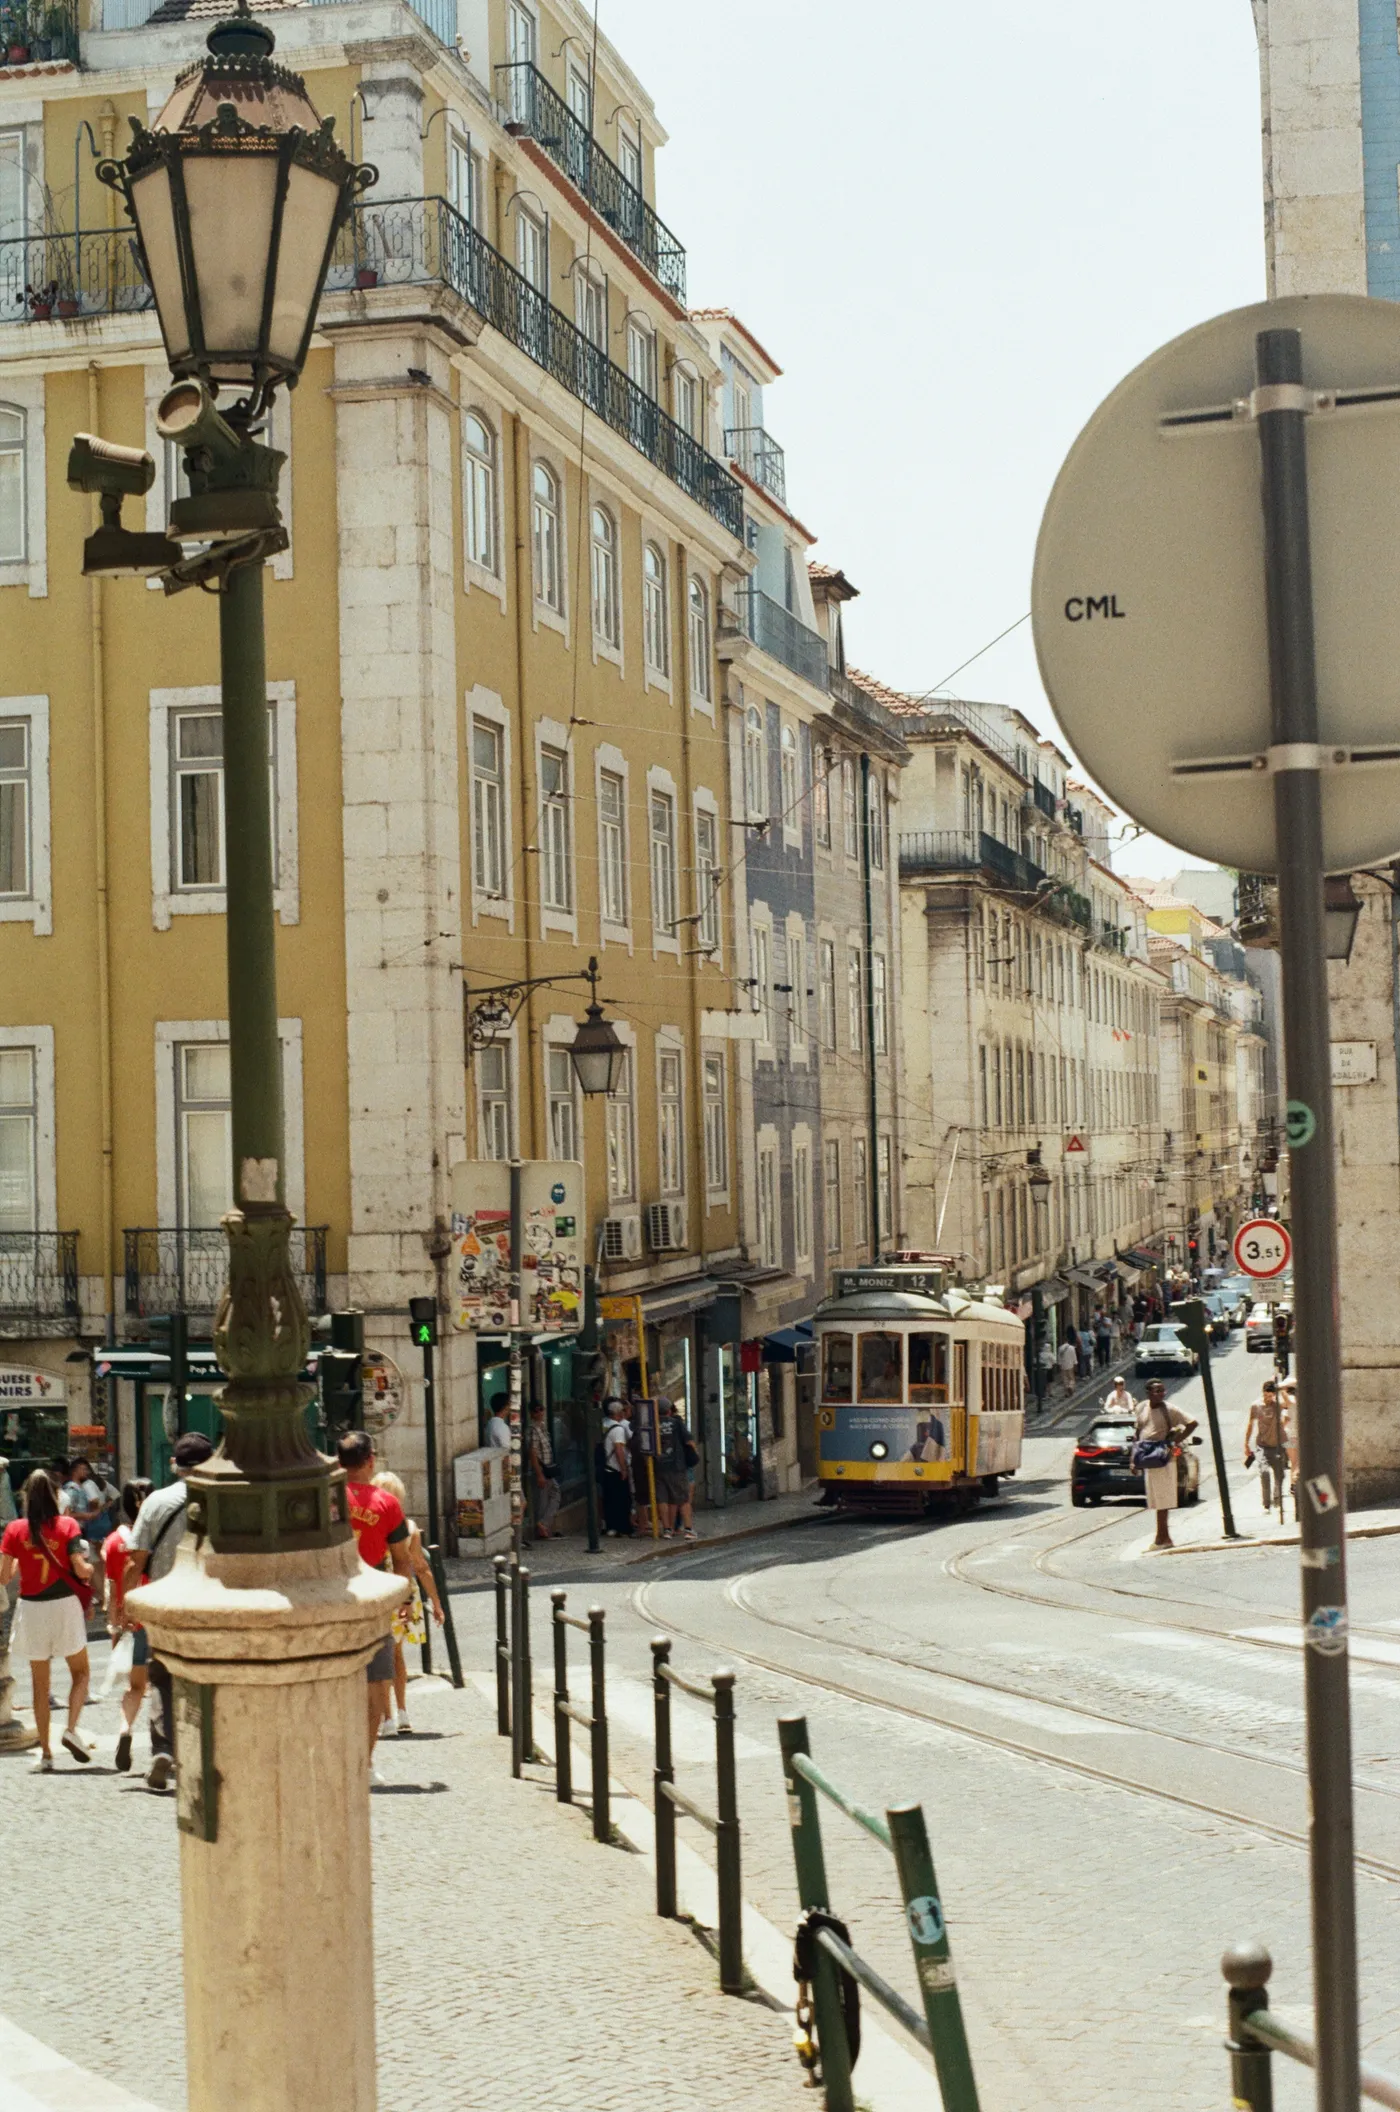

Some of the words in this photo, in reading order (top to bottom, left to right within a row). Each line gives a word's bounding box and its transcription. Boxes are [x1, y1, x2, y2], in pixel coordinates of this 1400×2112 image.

[1064, 594, 1126, 622] CML
[844, 1278, 856, 1286] M.
[859, 1278, 894, 1286] MONIZ
[911, 1275, 926, 1287] 12
[189, 1364, 208, 1376] Pop
[209, 1364, 217, 1374] &
[0, 1374, 32, 1385] UESE
[33, 1552, 50, 1585] 7
